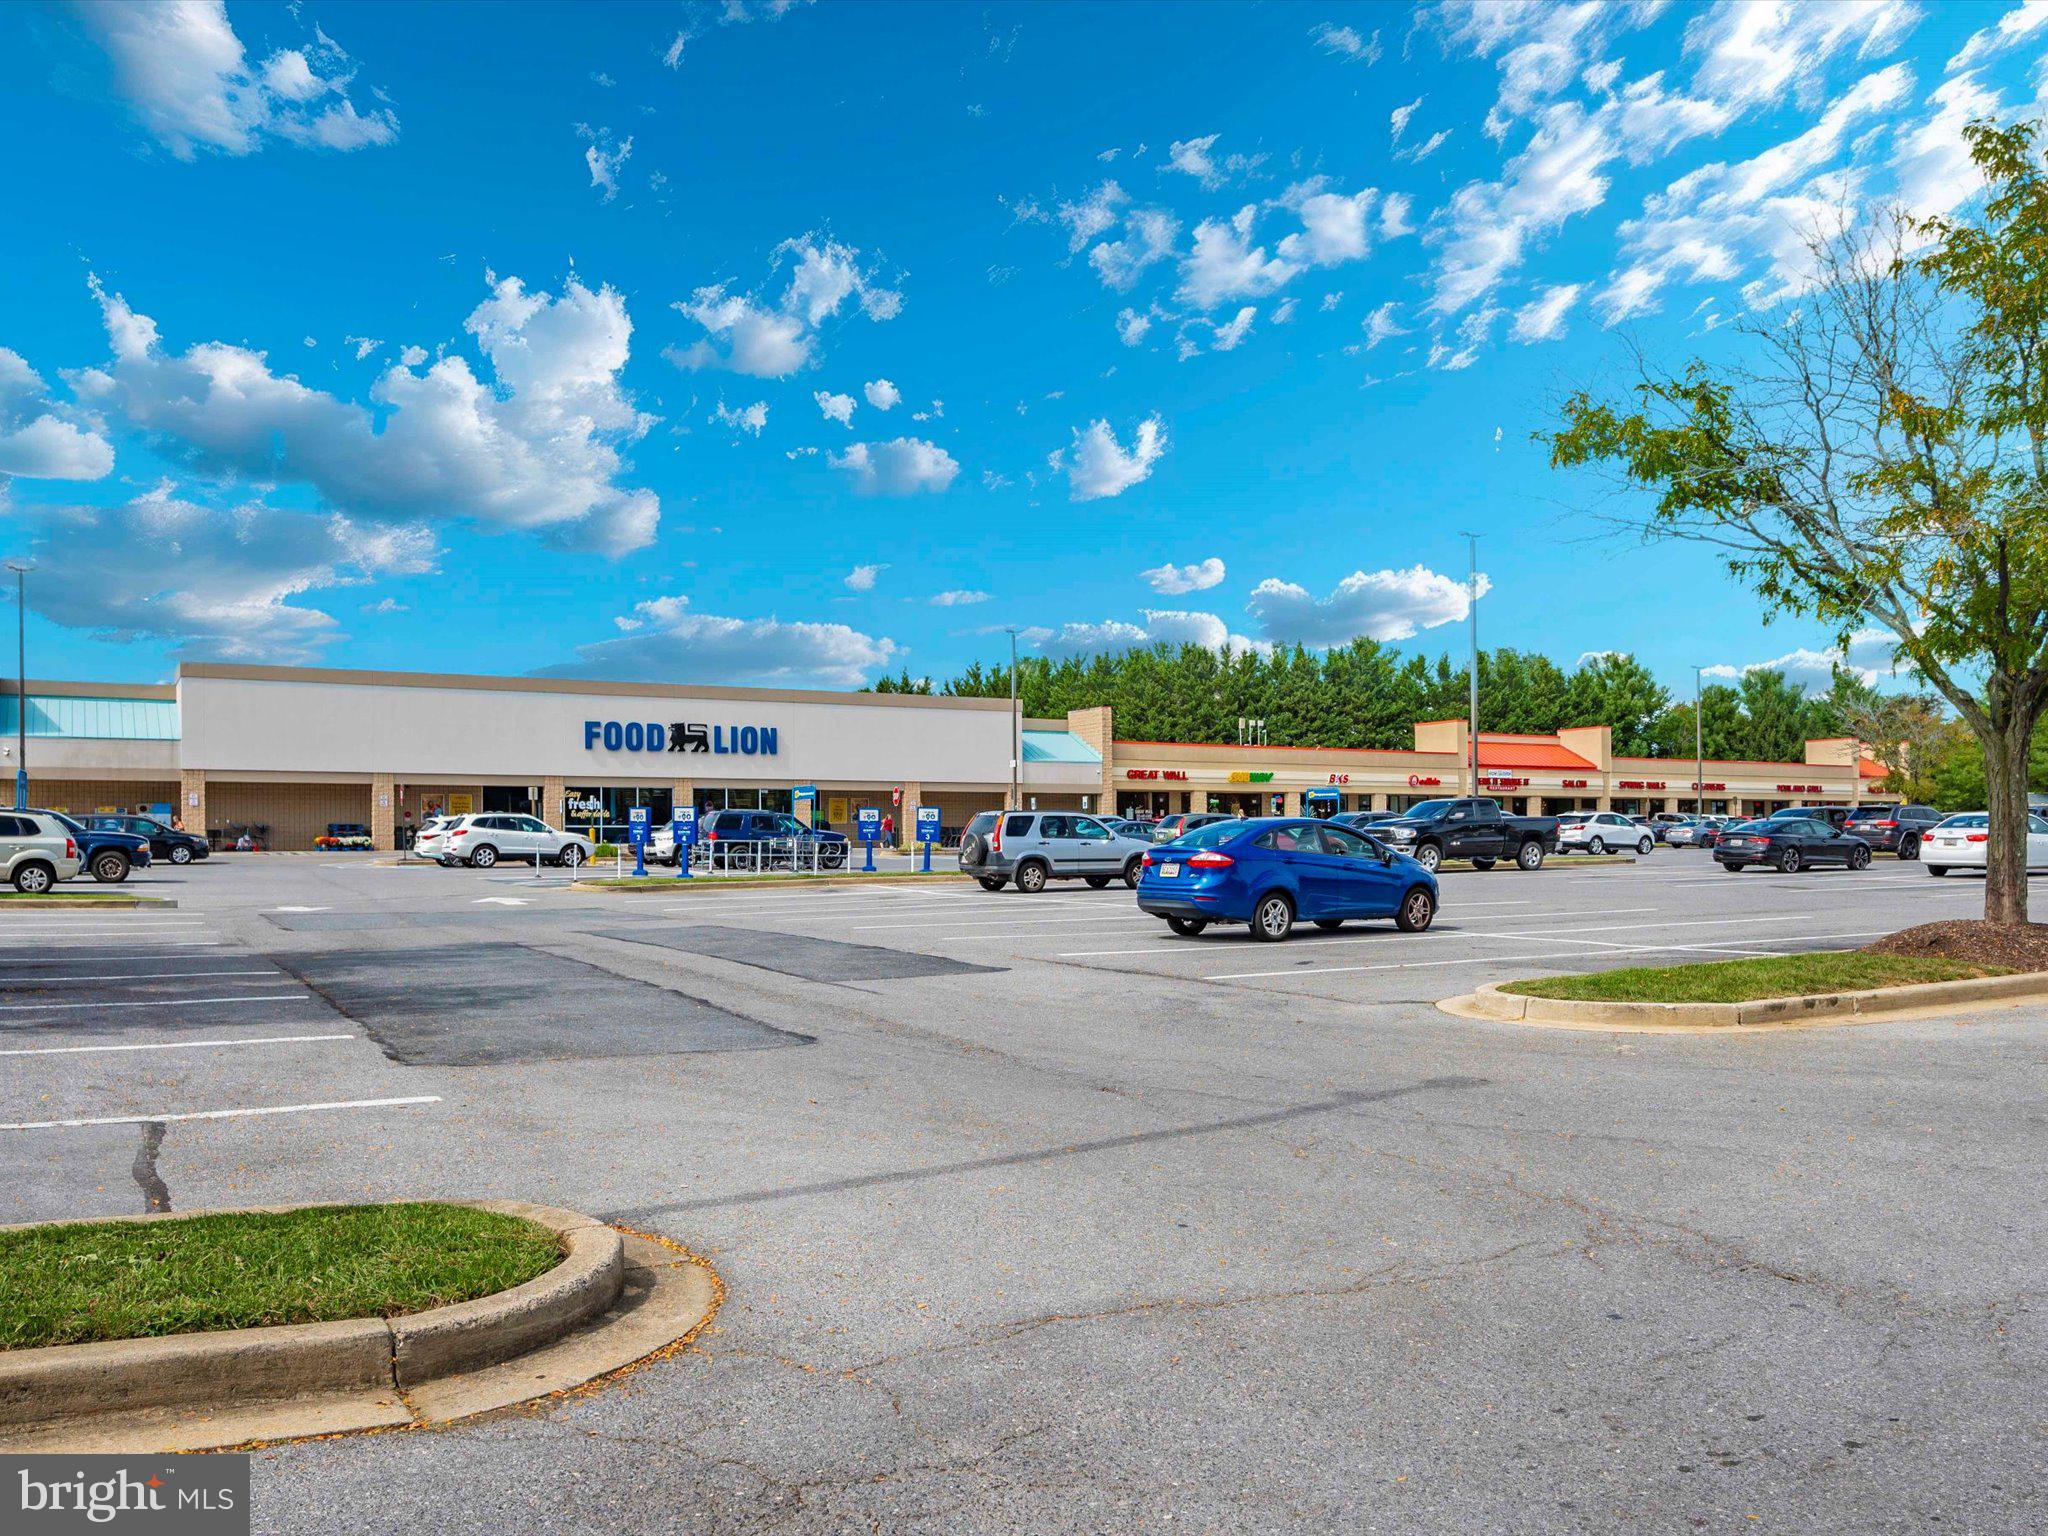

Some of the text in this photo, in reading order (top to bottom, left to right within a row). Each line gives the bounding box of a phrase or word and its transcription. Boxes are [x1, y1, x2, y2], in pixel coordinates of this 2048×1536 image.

[584, 721, 778, 755] FOOD LION
[1126, 769, 1189, 781] GREAT WALL
[1229, 771, 1274, 783] SUBWAY
[1562, 779, 1587, 788] SALON
[567, 795, 601, 810] fresh
